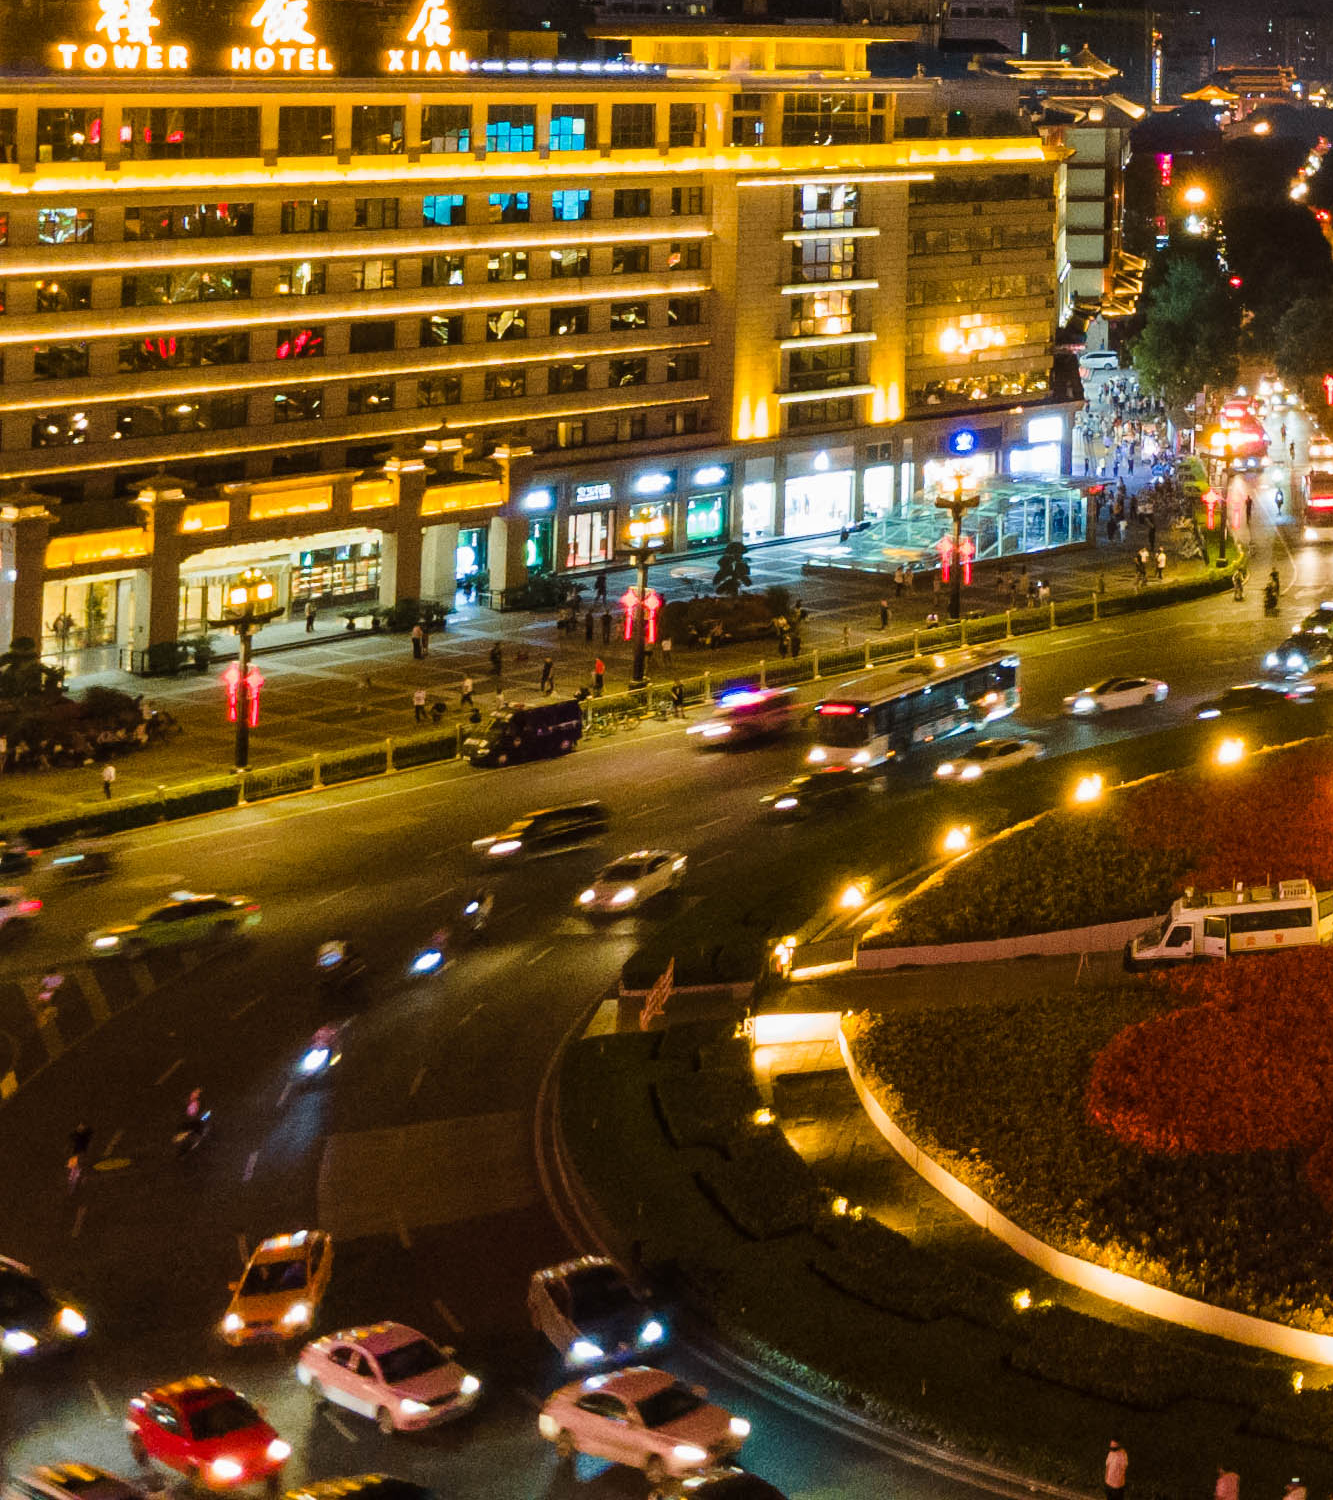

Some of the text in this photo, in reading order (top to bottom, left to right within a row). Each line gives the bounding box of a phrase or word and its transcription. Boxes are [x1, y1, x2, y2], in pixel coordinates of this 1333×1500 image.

[57, 44, 468, 72] TOWER HOTEL XIAN
